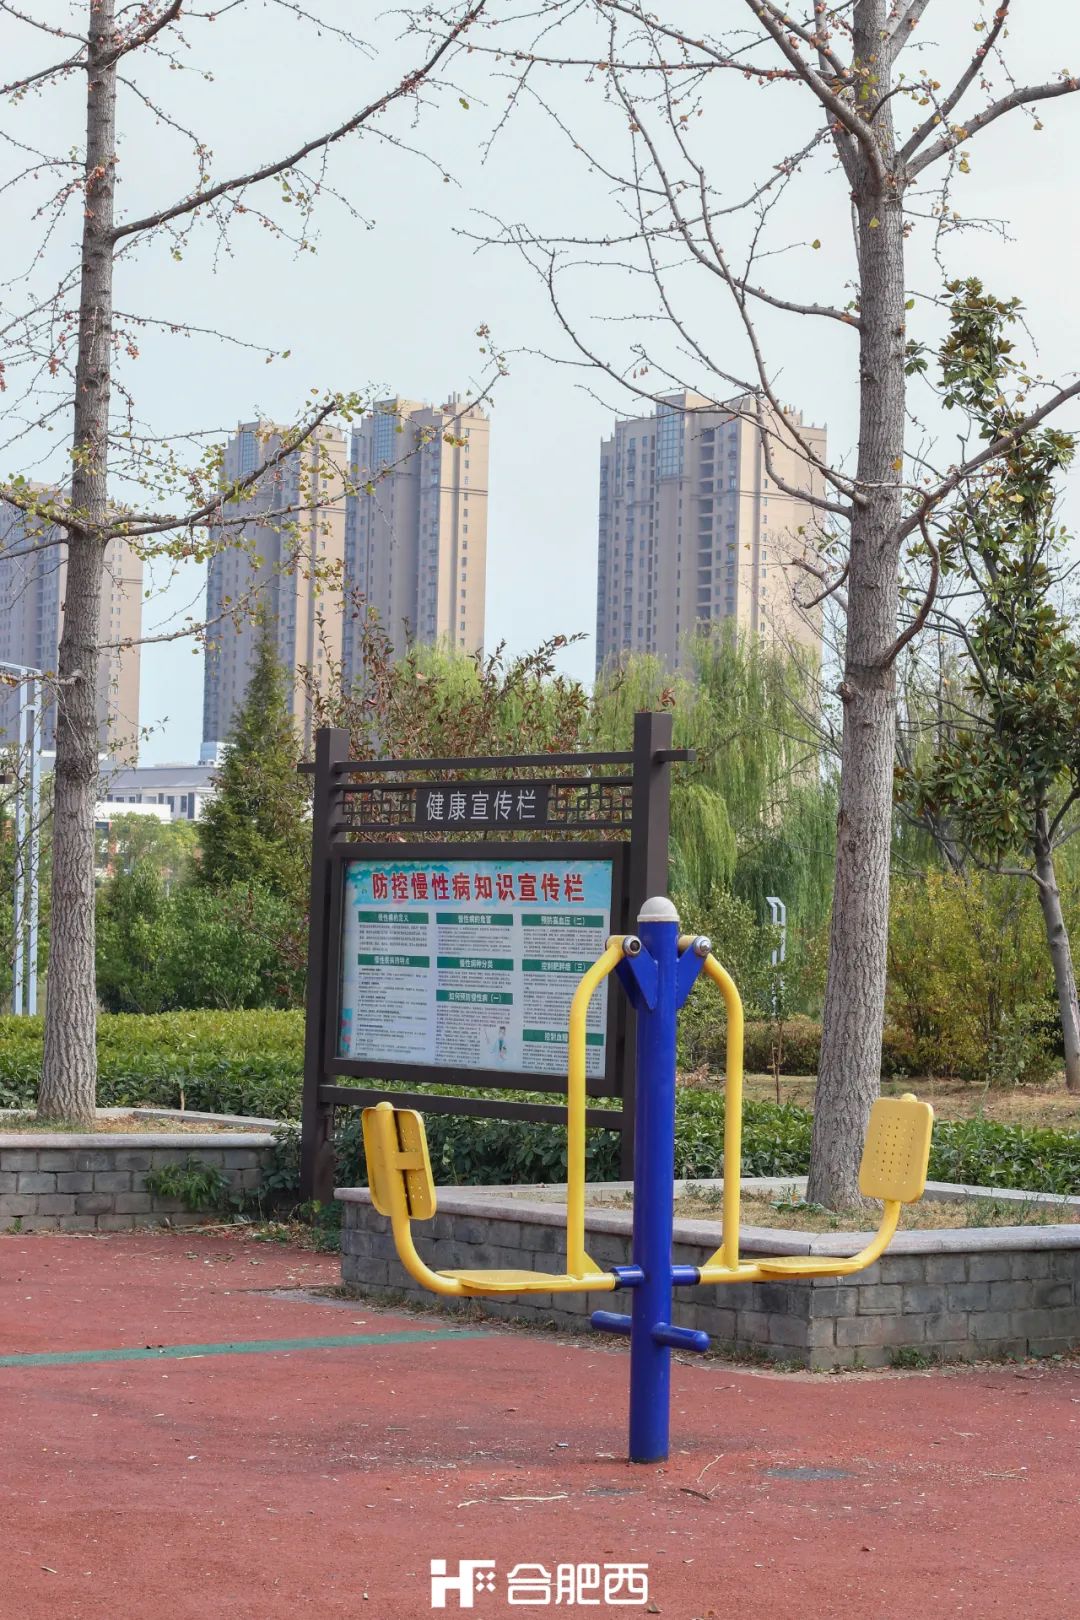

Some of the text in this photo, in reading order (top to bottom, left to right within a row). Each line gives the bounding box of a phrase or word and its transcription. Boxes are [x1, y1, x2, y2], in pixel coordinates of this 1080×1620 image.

[426, 790, 536, 820] 健康宣传栏
[372, 872, 585, 902] 防控慢性病知识宣传栏
